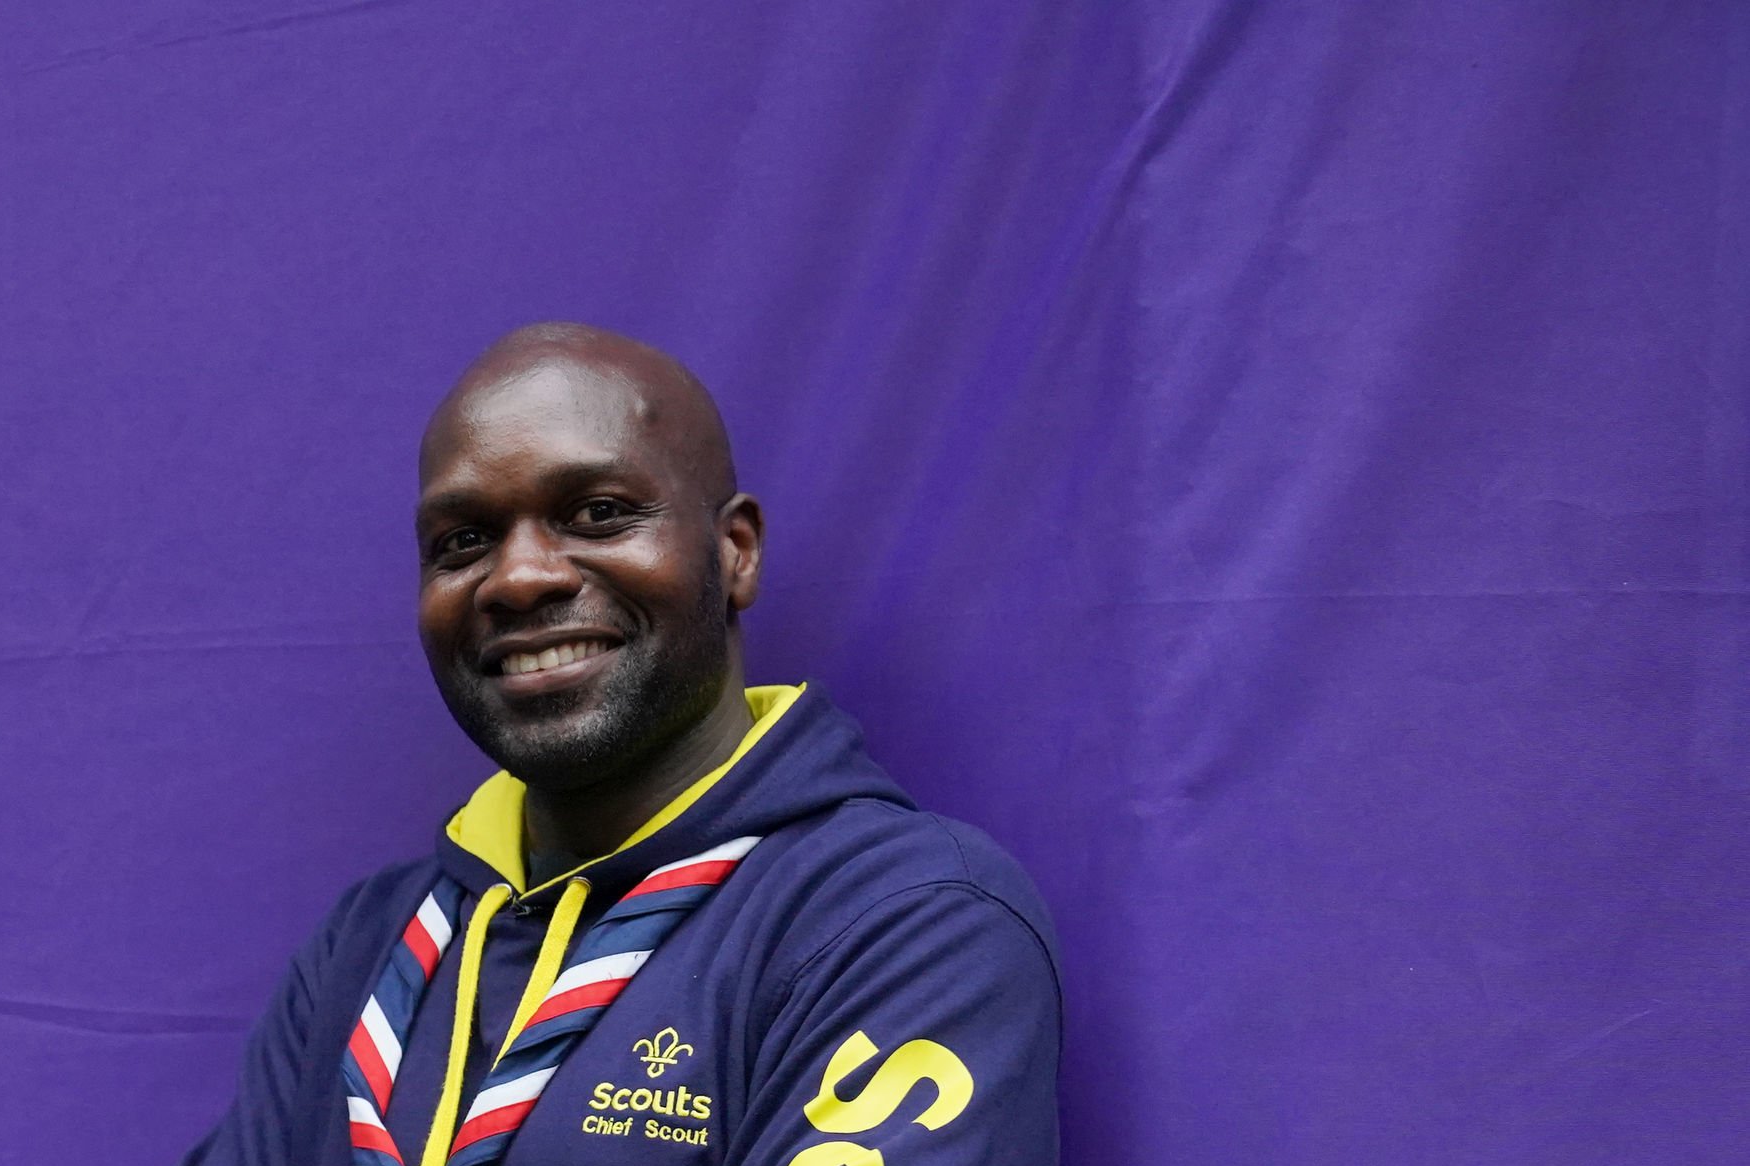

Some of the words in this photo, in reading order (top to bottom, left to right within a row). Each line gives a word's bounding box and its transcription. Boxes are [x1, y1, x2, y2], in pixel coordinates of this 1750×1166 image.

[588, 1082, 712, 1120] Scouts
[582, 1115, 634, 1136] Chief
[644, 1119, 709, 1146] Scout
